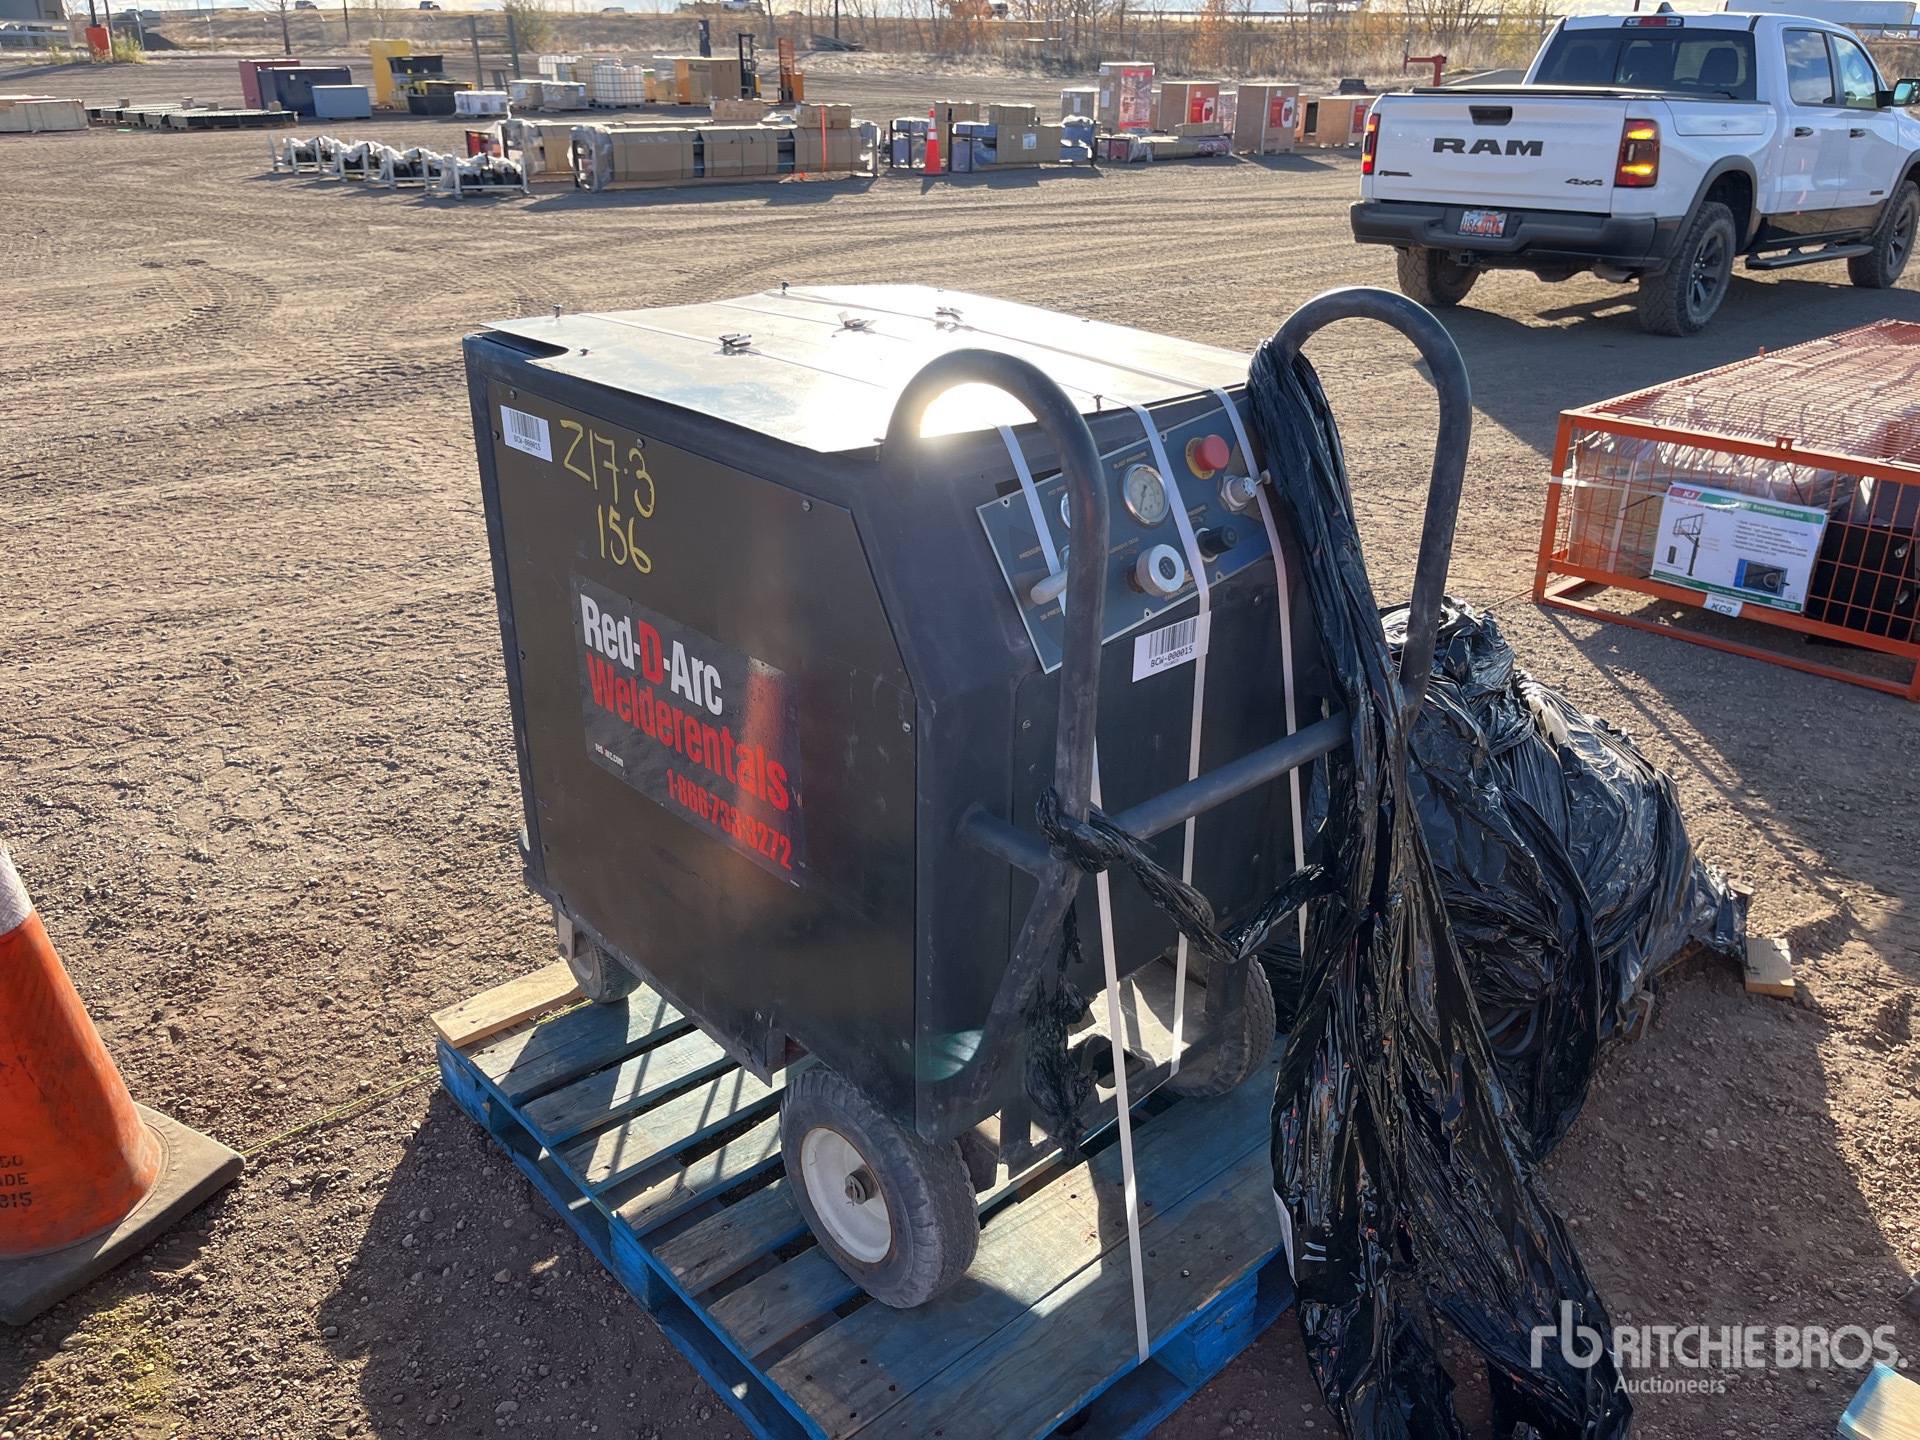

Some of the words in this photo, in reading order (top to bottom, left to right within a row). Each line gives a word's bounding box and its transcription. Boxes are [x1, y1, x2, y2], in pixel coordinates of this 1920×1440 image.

[1432, 137, 1544, 156] RAM
[598, 504, 651, 574] 156
[579, 593, 724, 716] Red-D-Arc
[1150, 644, 1193, 668] BCW-000015
[585, 652, 789, 811] Welderentals
[666, 768, 792, 871] 1-866-733-3272
